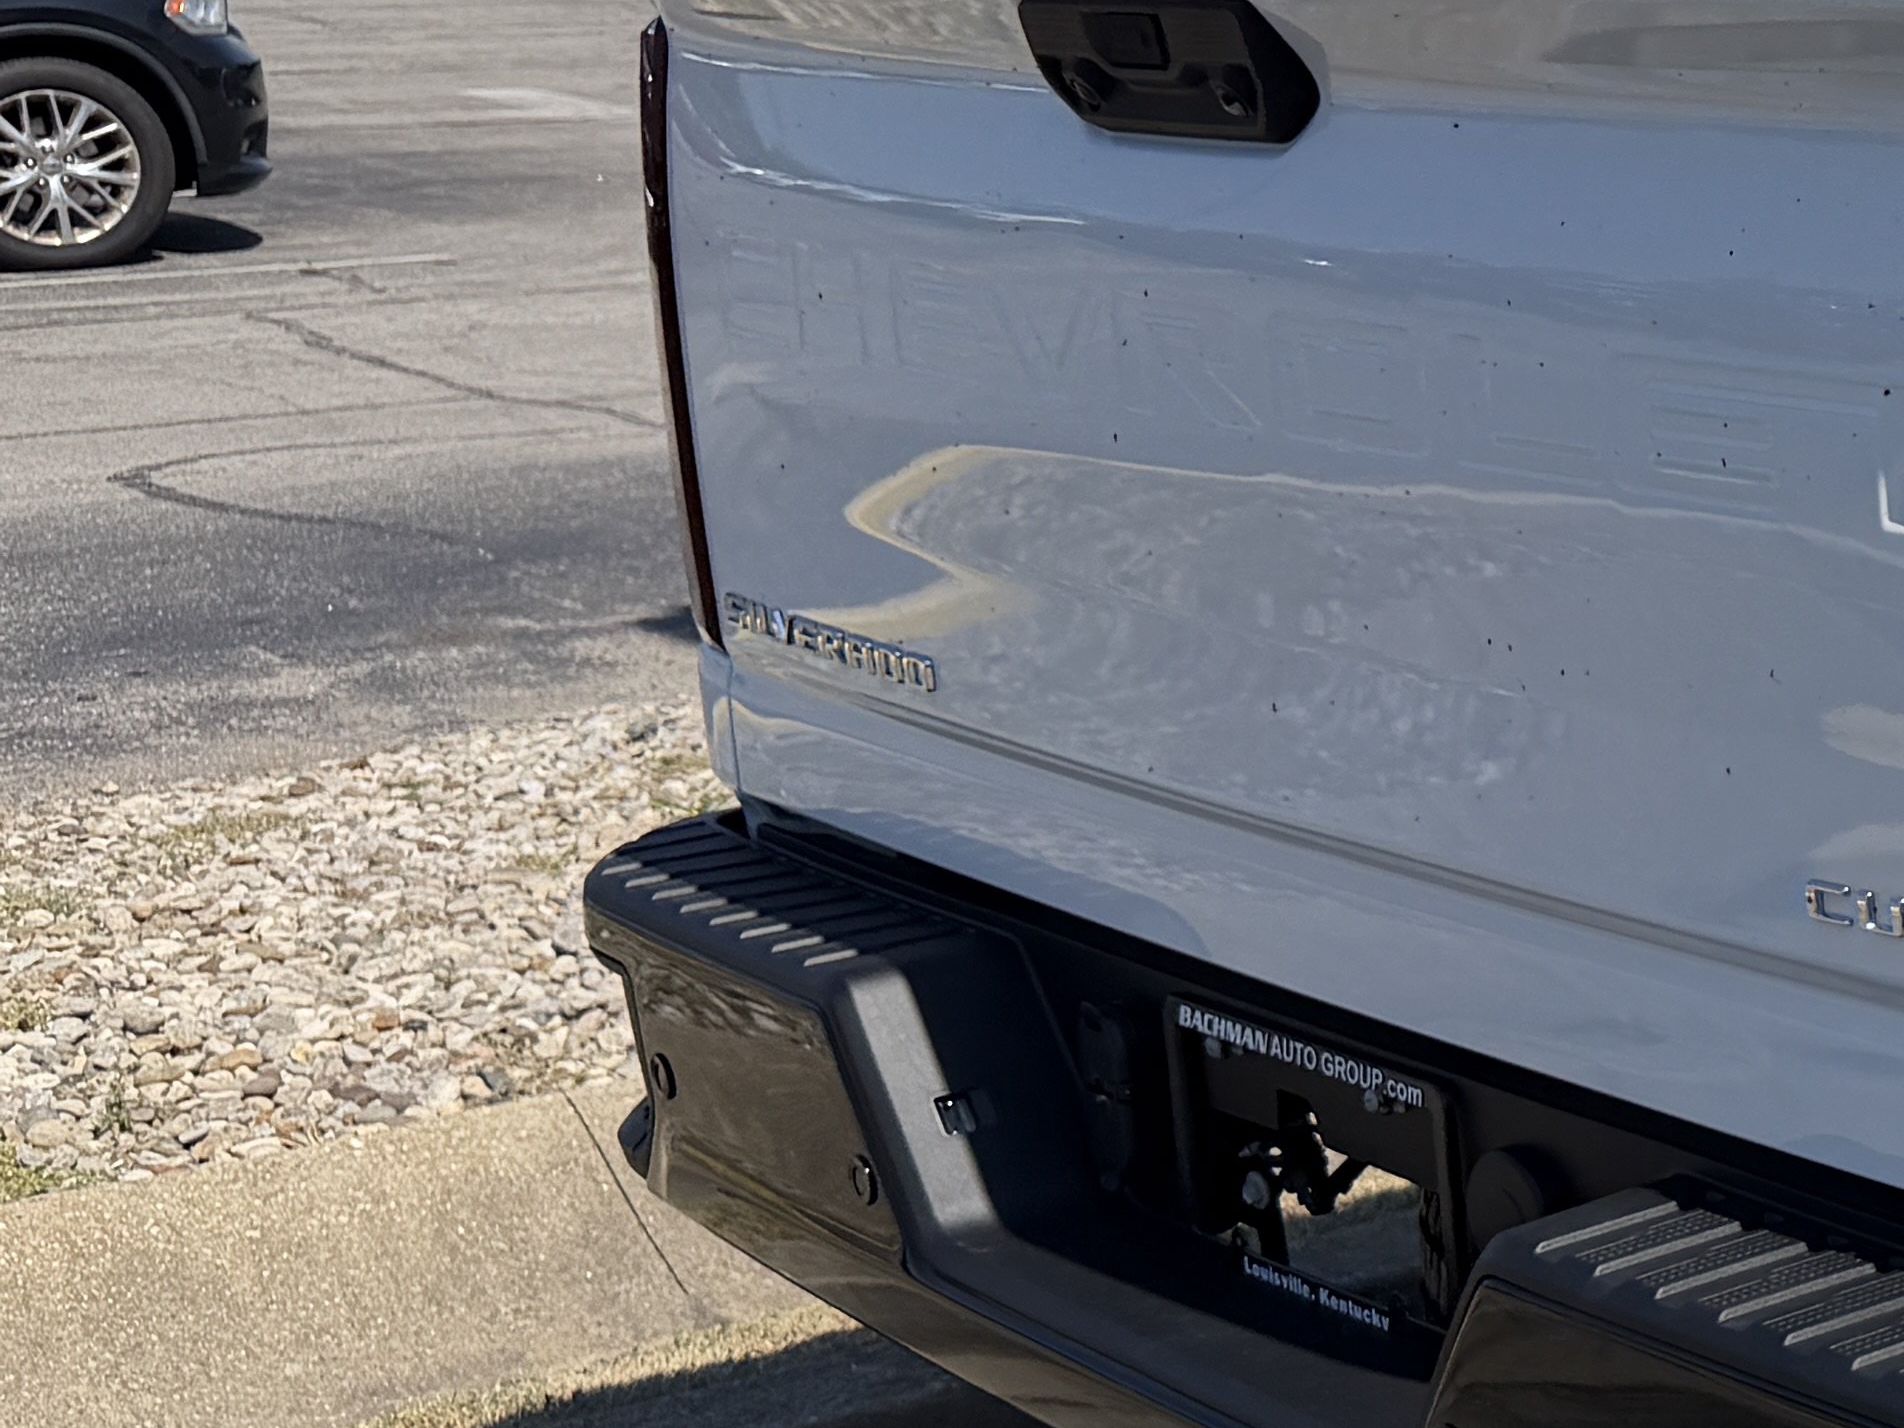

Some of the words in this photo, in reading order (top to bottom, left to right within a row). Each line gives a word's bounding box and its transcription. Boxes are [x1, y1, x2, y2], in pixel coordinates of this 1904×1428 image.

[724, 591, 938, 692] SILVERADO
[1178, 1004, 1268, 1054] BACHMAN
[1270, 1033, 1317, 1070] AUTO
[1319, 1287, 1390, 1332] Kentucky
